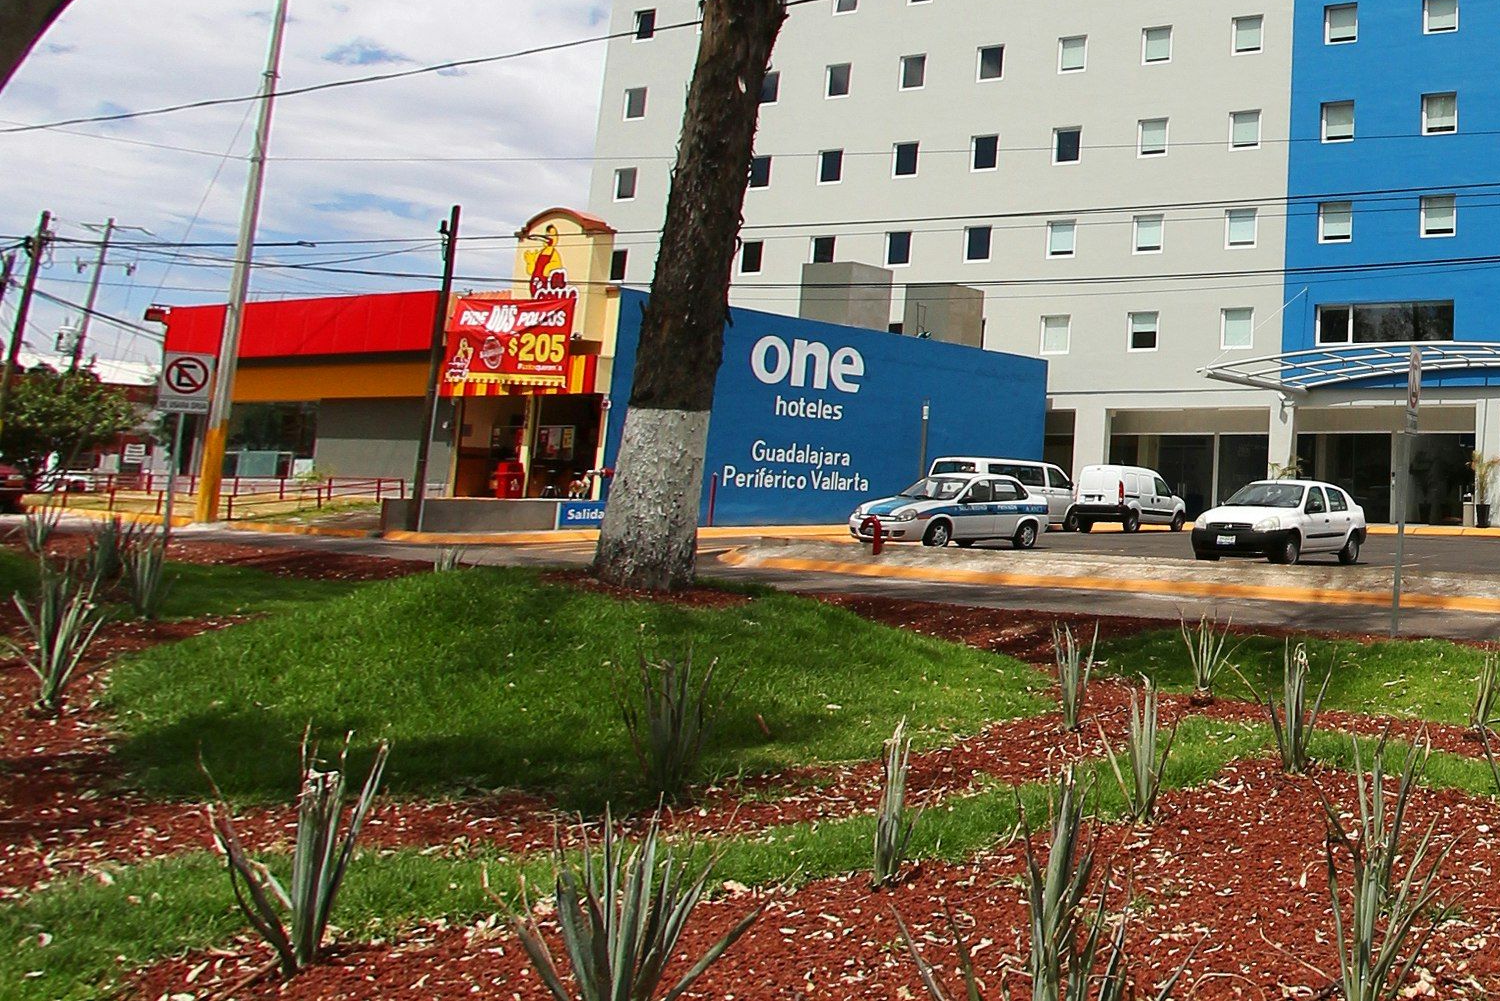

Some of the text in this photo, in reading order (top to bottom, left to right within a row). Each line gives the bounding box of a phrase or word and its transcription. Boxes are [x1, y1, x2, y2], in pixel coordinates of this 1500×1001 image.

[508, 332, 566, 363] $205
[751, 335, 865, 393] one
[775, 395, 844, 420] hoteles
[752, 440, 851, 469] Guadalajara
[722, 465, 869, 492] Periférico Vallarta
[567, 508, 606, 520] Salida
